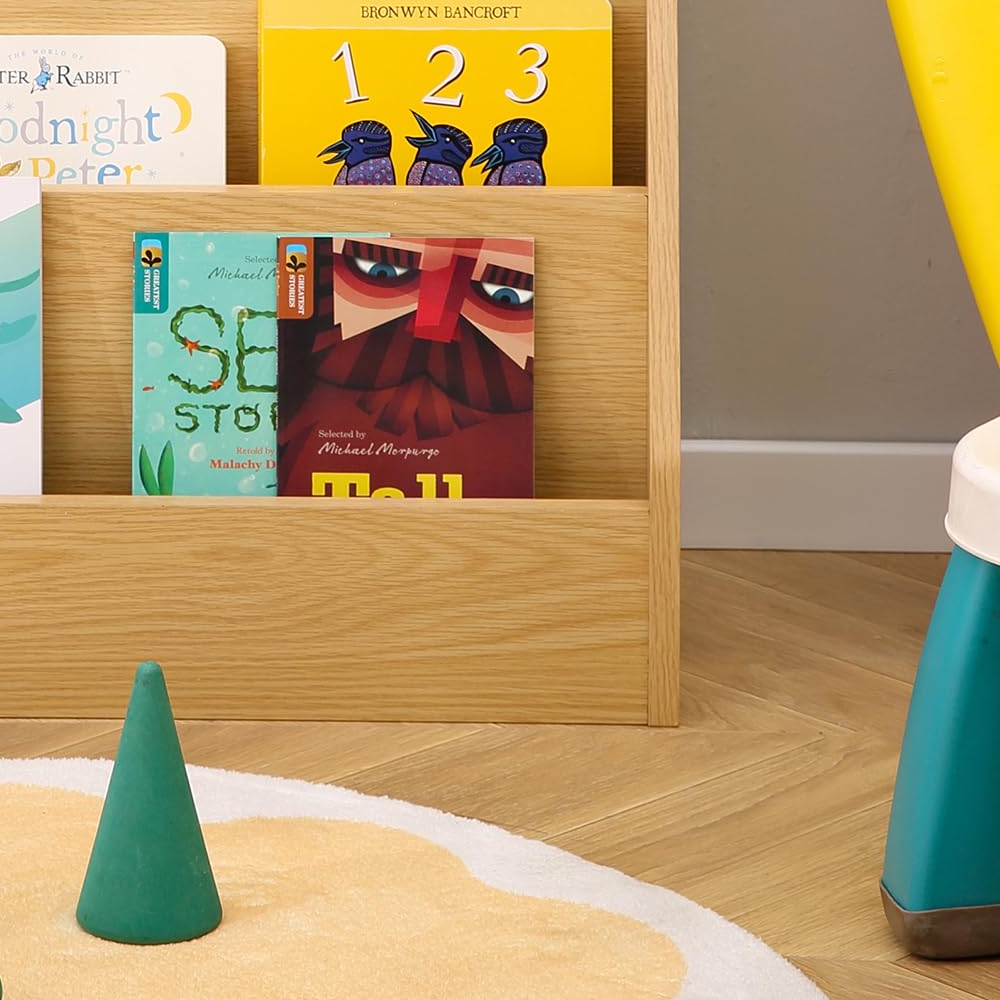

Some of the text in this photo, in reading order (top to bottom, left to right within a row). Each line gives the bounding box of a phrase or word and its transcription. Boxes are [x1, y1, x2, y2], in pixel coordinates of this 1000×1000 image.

[361, 5, 522, 20] BRONWYN BANCROFT
[55, 64, 122, 88] RABBIT
[331, 40, 549, 108] 1 2 3
[28, 157, 143, 184] Peter
[207, 267, 263, 280] Michael
[168, 304, 277, 394] SE
[318, 430, 366, 441] Selected by
[236, 446, 275, 457] Retold by
[317, 442, 440, 460] Michael Morpurgo
[210, 459, 262, 471] Malachy
